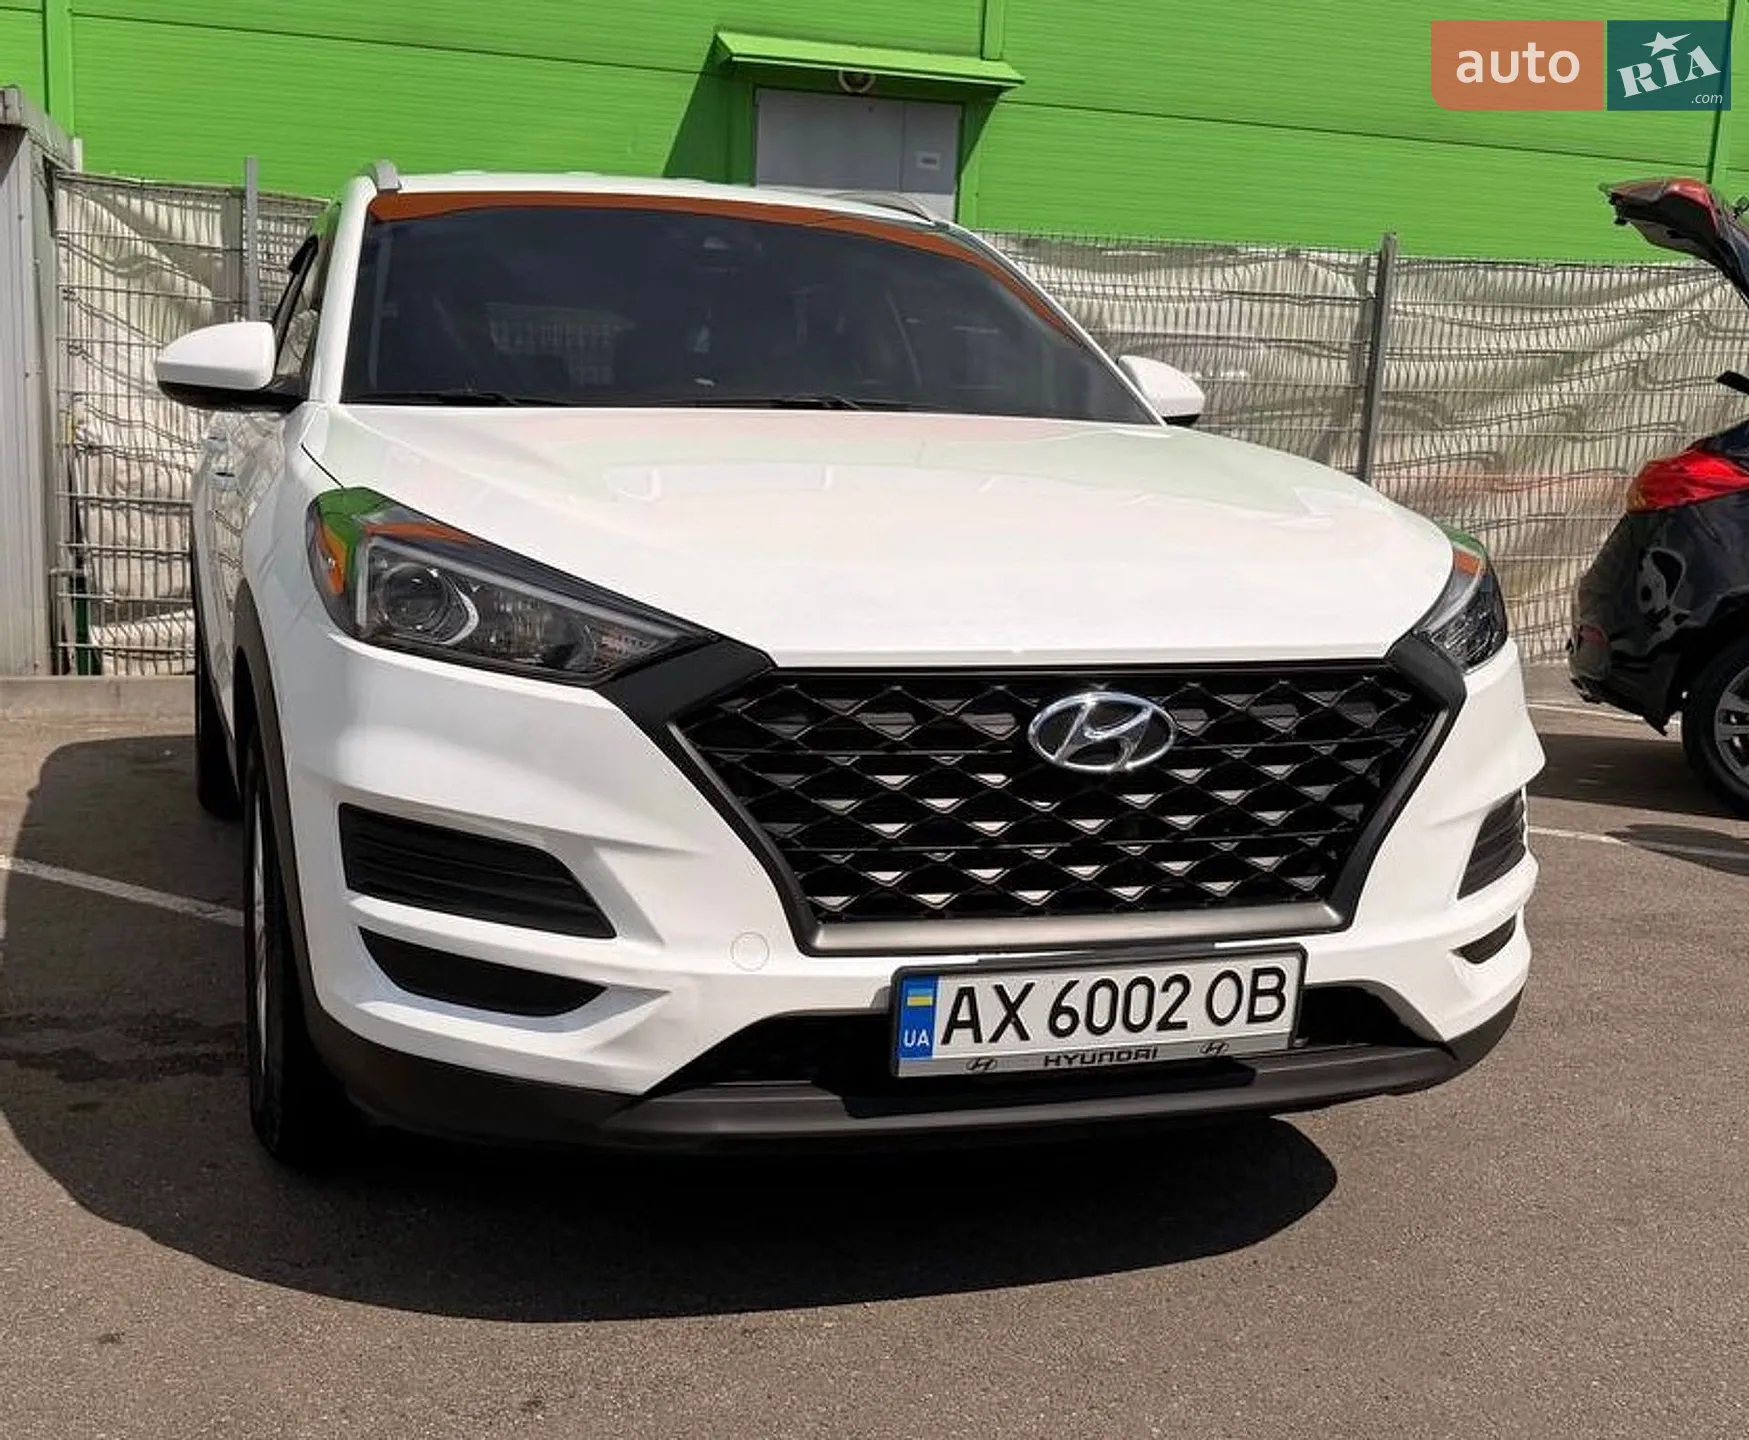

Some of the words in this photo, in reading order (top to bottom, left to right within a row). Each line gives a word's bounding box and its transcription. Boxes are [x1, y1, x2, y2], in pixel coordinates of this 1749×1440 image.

[940, 982, 1036, 1046] AX
[1047, 973, 1192, 1039] 6002
[1205, 966, 1288, 1027] OB
[903, 1031, 930, 1048] UA
[1043, 1047, 1158, 1069] HYUNDAI
